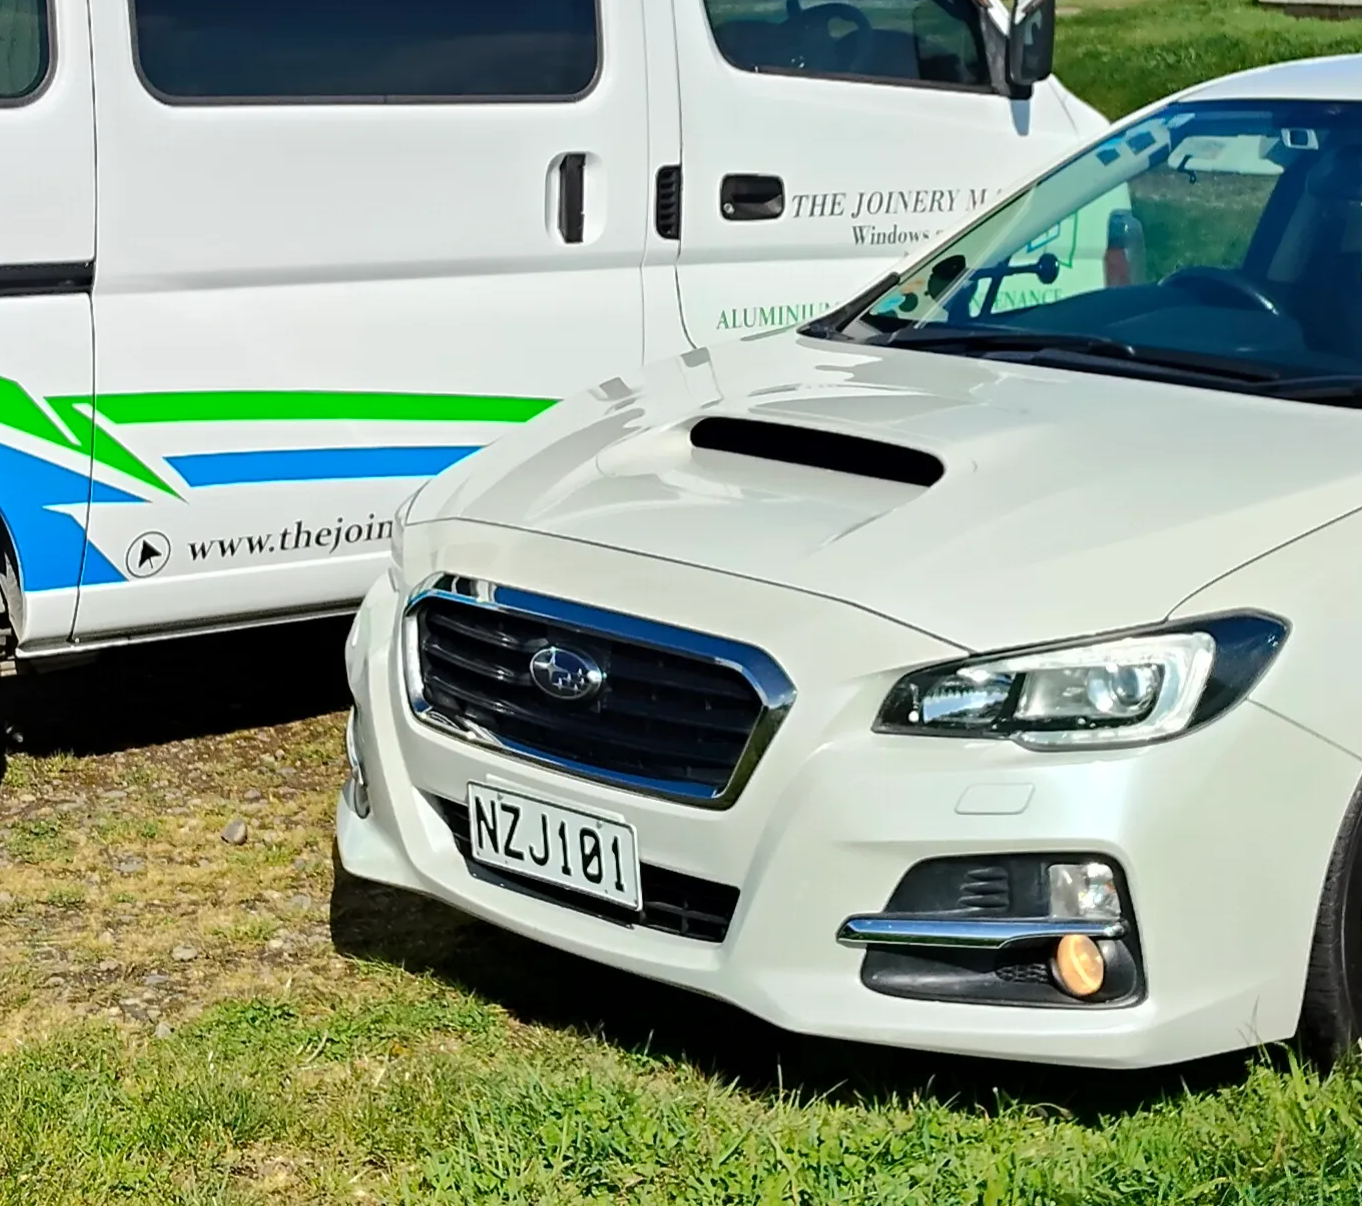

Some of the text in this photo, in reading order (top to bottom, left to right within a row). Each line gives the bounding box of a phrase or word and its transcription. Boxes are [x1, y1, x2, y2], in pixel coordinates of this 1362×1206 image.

[792, 192, 847, 218] THE
[851, 188, 960, 219] JOINERY
[852, 224, 930, 246] Windows
[716, 302, 830, 330] ALUMINIU
[188, 513, 393, 561] www.thejoin
[475, 795, 625, 893] NZJ101
